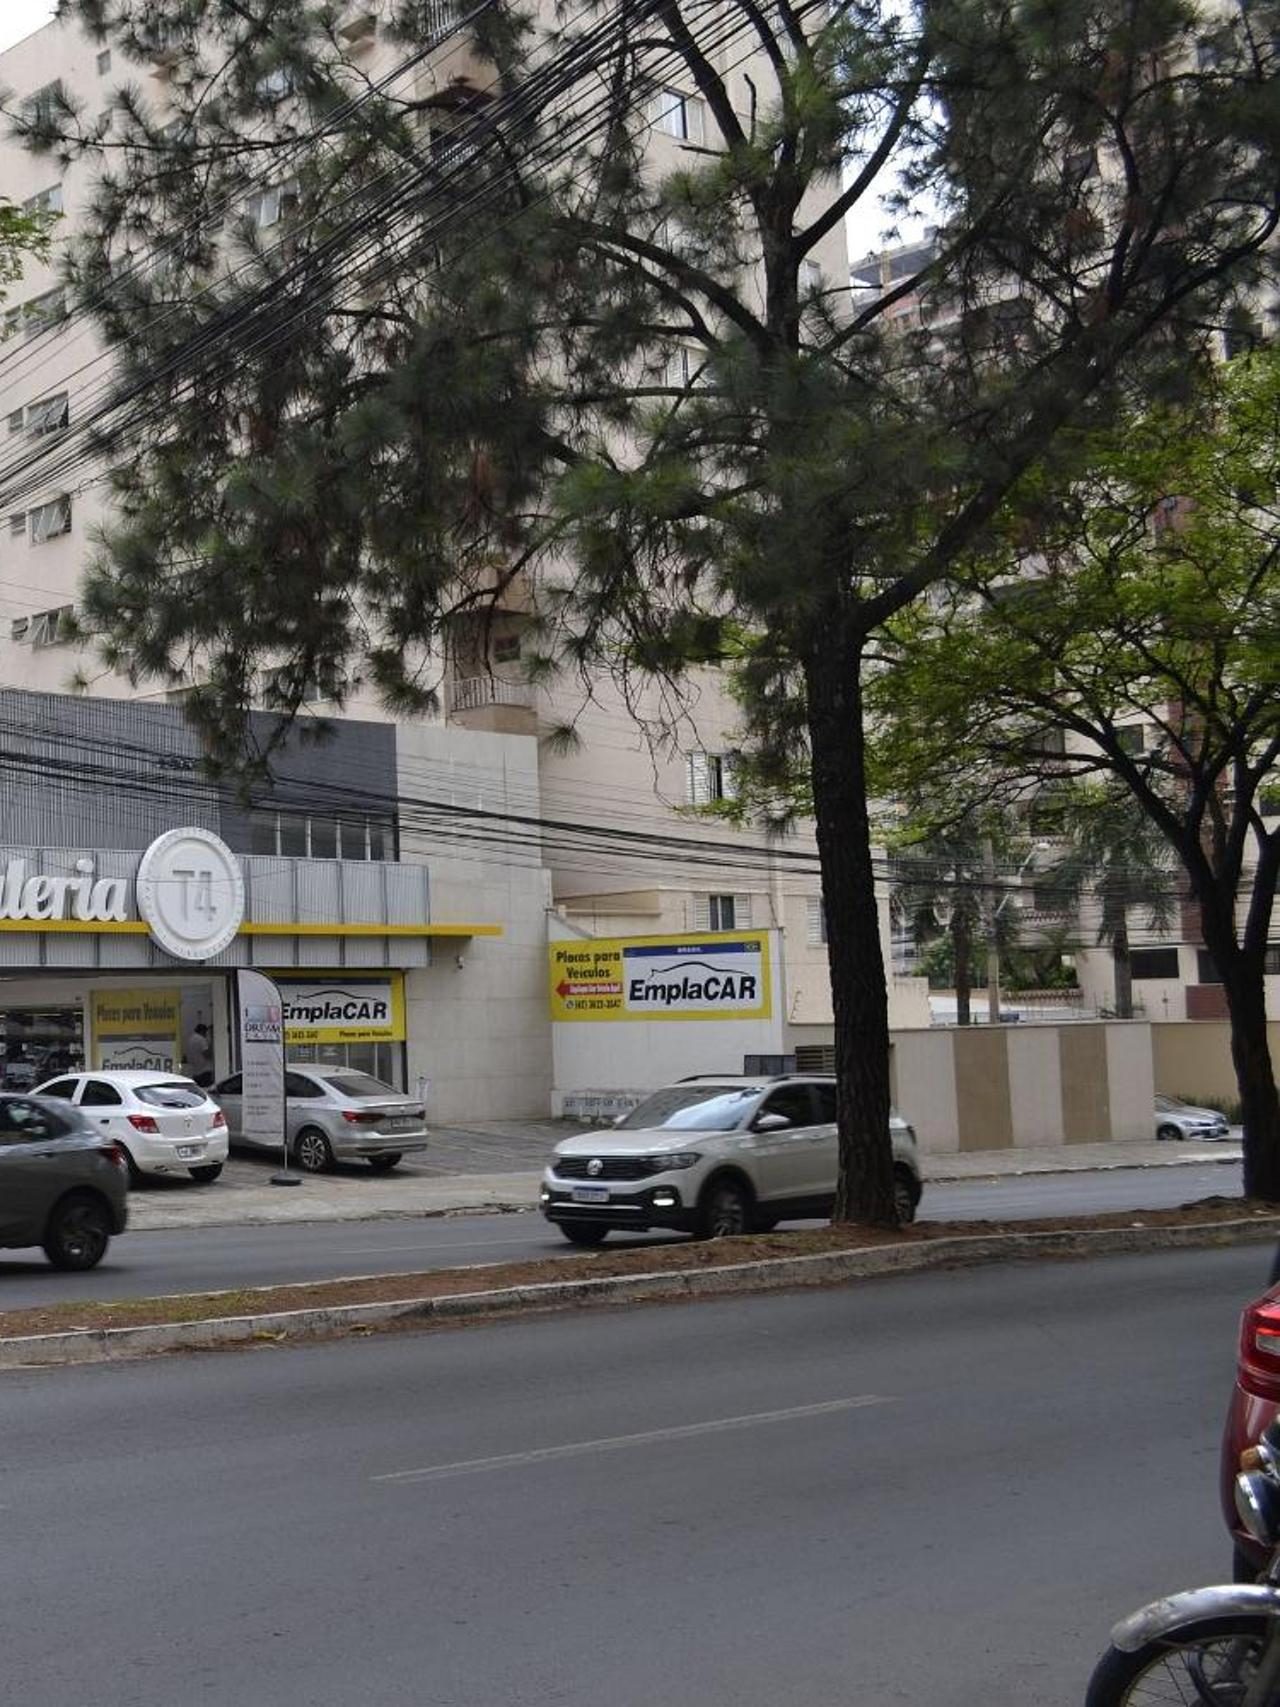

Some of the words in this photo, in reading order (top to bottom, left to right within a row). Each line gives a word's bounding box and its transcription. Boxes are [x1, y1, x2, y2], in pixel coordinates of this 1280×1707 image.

[172, 869, 218, 922] T4
[594, 952, 620, 965] para
[629, 976, 757, 1005] EmplaCAR
[282, 1001, 387, 1022] EmplaCAR
